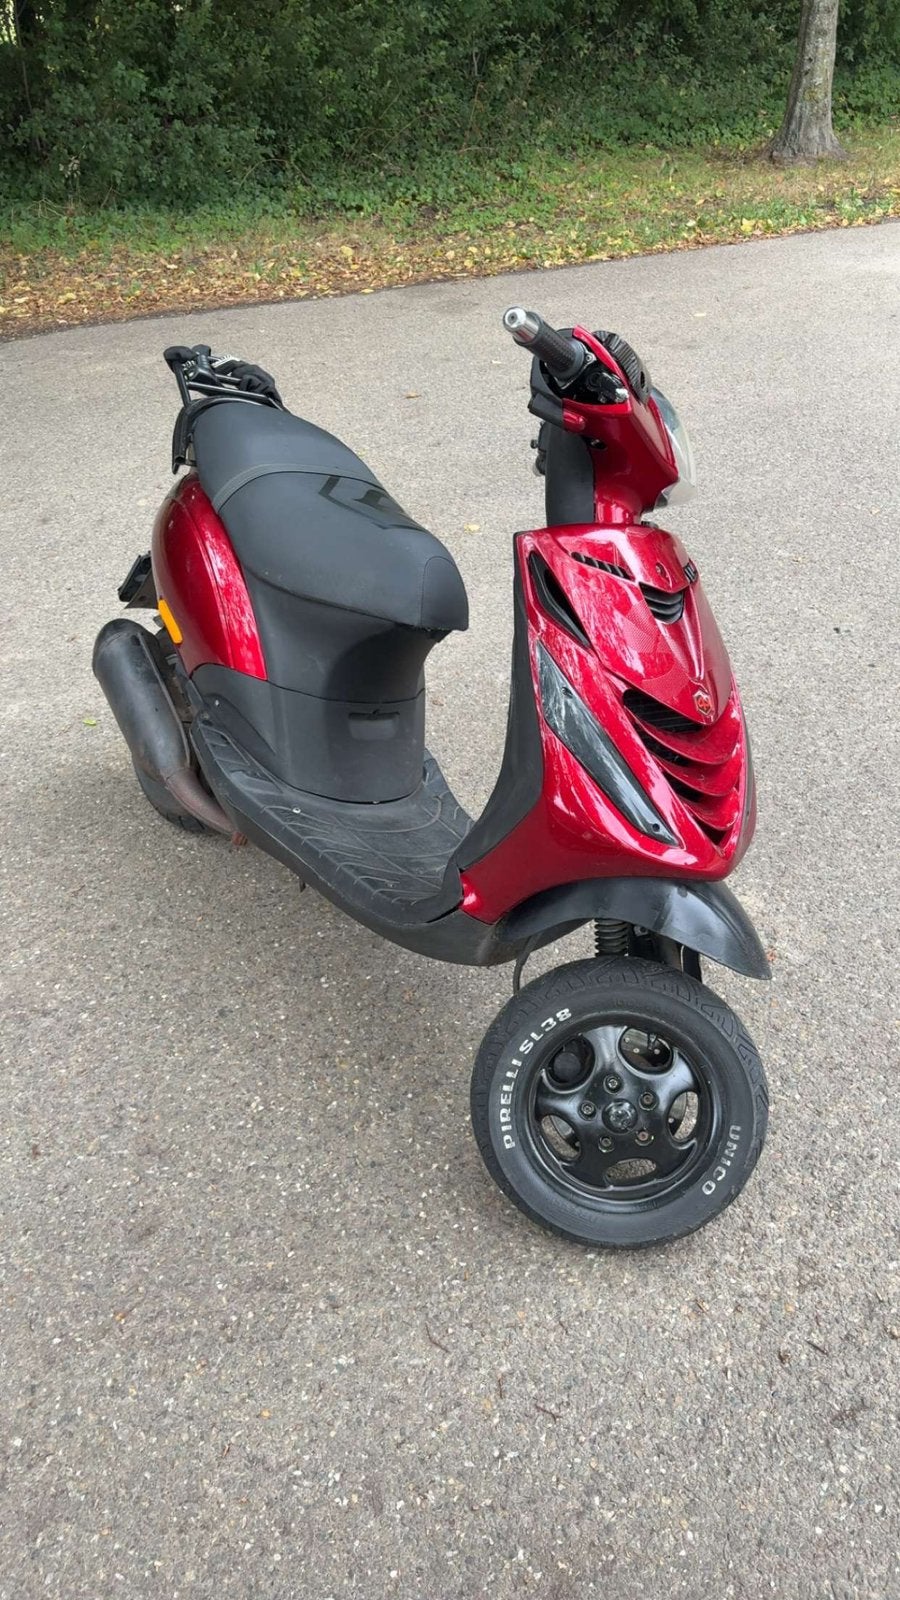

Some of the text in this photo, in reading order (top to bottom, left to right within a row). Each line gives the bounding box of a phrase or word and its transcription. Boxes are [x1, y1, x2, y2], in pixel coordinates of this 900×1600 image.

[500, 1008, 572, 1150] PIRELLI SL38
[701, 1125, 742, 1195] UNICO
